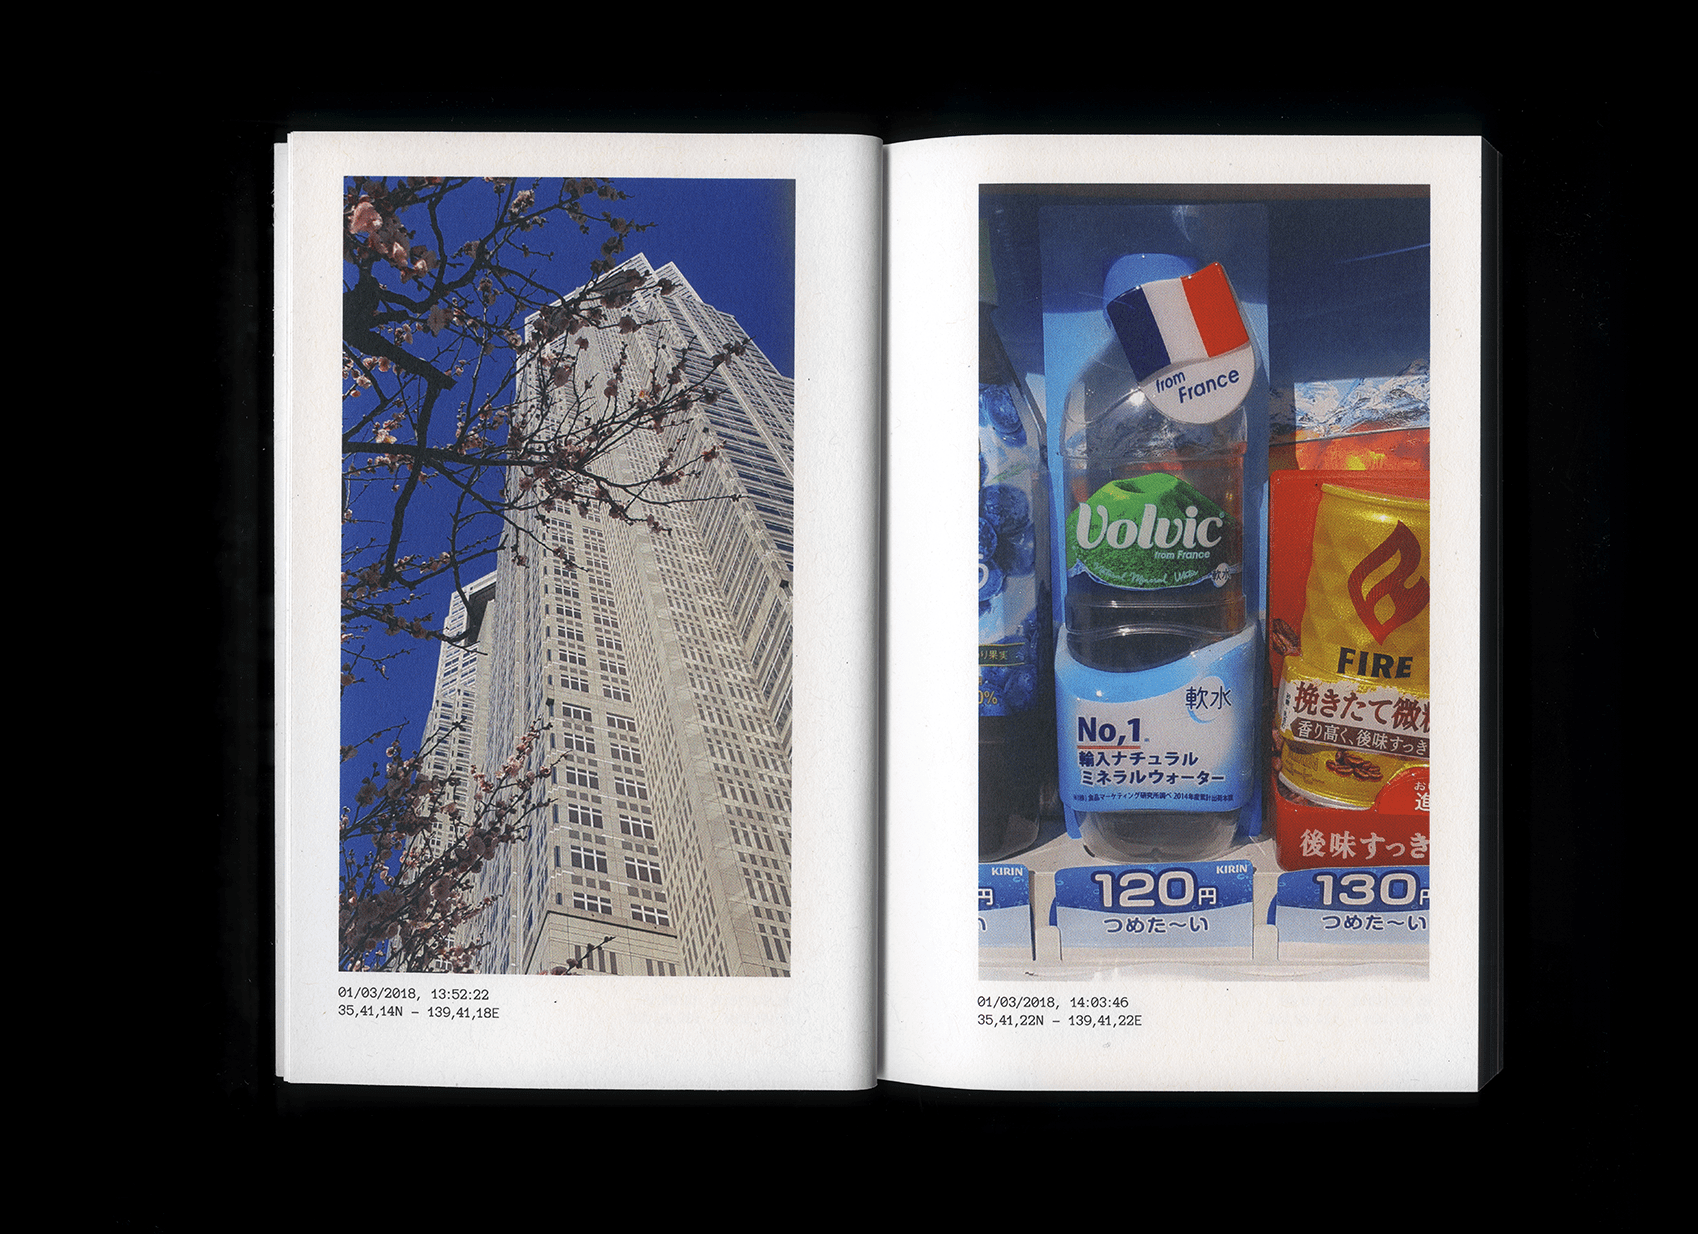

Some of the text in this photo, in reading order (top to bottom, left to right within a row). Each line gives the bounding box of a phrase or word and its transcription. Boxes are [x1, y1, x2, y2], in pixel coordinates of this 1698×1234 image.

[1155, 371, 1186, 394] from
[1178, 369, 1240, 404] France
[1076, 502, 1224, 549] Volvic
[1154, 550, 1211, 560] from France
[1336, 646, 1414, 679] FIRE
[1185, 685, 1232, 710] 軟水
[1079, 750, 1199, 767] 輸入ナチュラル
[1082, 769, 1225, 786] ミネラルウォーター
[1299, 828, 1430, 860] 後味すっき
[991, 867, 1023, 876] KIRIN
[1216, 864, 1248, 874] KIRIN
[337, 986, 490, 1001] 01/03/2018, 13:52:22
[977, 996, 1129, 1010] 01/03/2018, 14:03:46
[338, 1004, 403, 1018] 35,41,14N
[427, 1006, 500, 1020] 139,41,18E
[977, 1014, 1044, 1028] 35,41,22N
[1068, 1014, 1143, 1028] 139,41,22E
